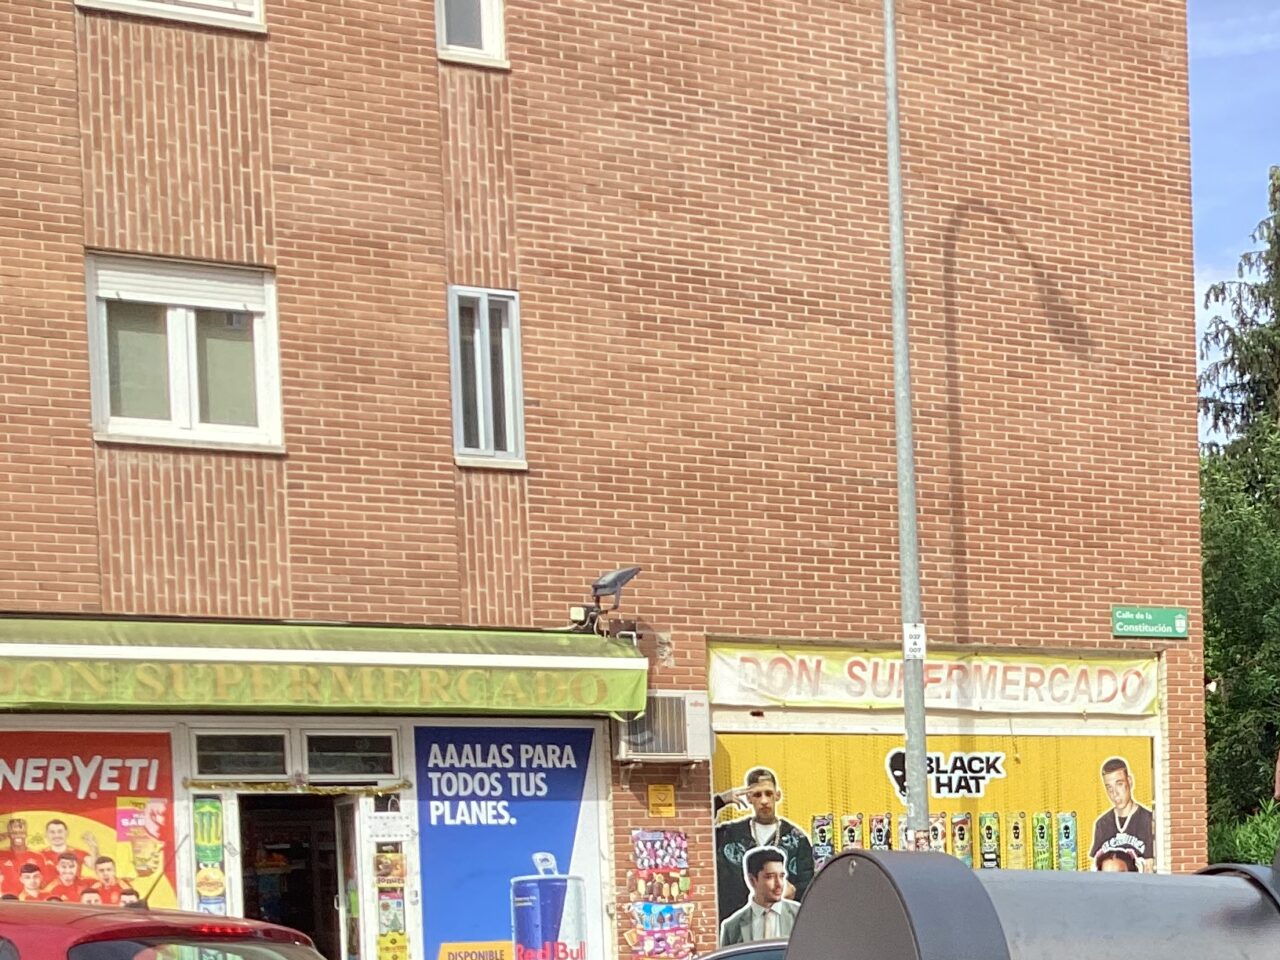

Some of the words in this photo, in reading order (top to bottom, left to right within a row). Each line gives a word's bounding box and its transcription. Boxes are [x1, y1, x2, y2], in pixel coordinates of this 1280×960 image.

[1115, 610, 1133, 619] Calle
[1134, 611, 1144, 620] de
[1145, 612, 1153, 620] la
[1115, 621, 1172, 633] Constitución
[135, 661, 609, 706] SUPERMERCADO
[739, 655, 823, 698] DON
[846, 659, 1147, 707] SUERMERCADO
[428, 743, 514, 769] AAALAS
[520, 744, 577, 769] PARA
[428, 772, 503, 797] TODOS
[507, 773, 548, 797] TUS
[935, 775, 986, 794] HAT
[430, 801, 517, 826] PLANES.
